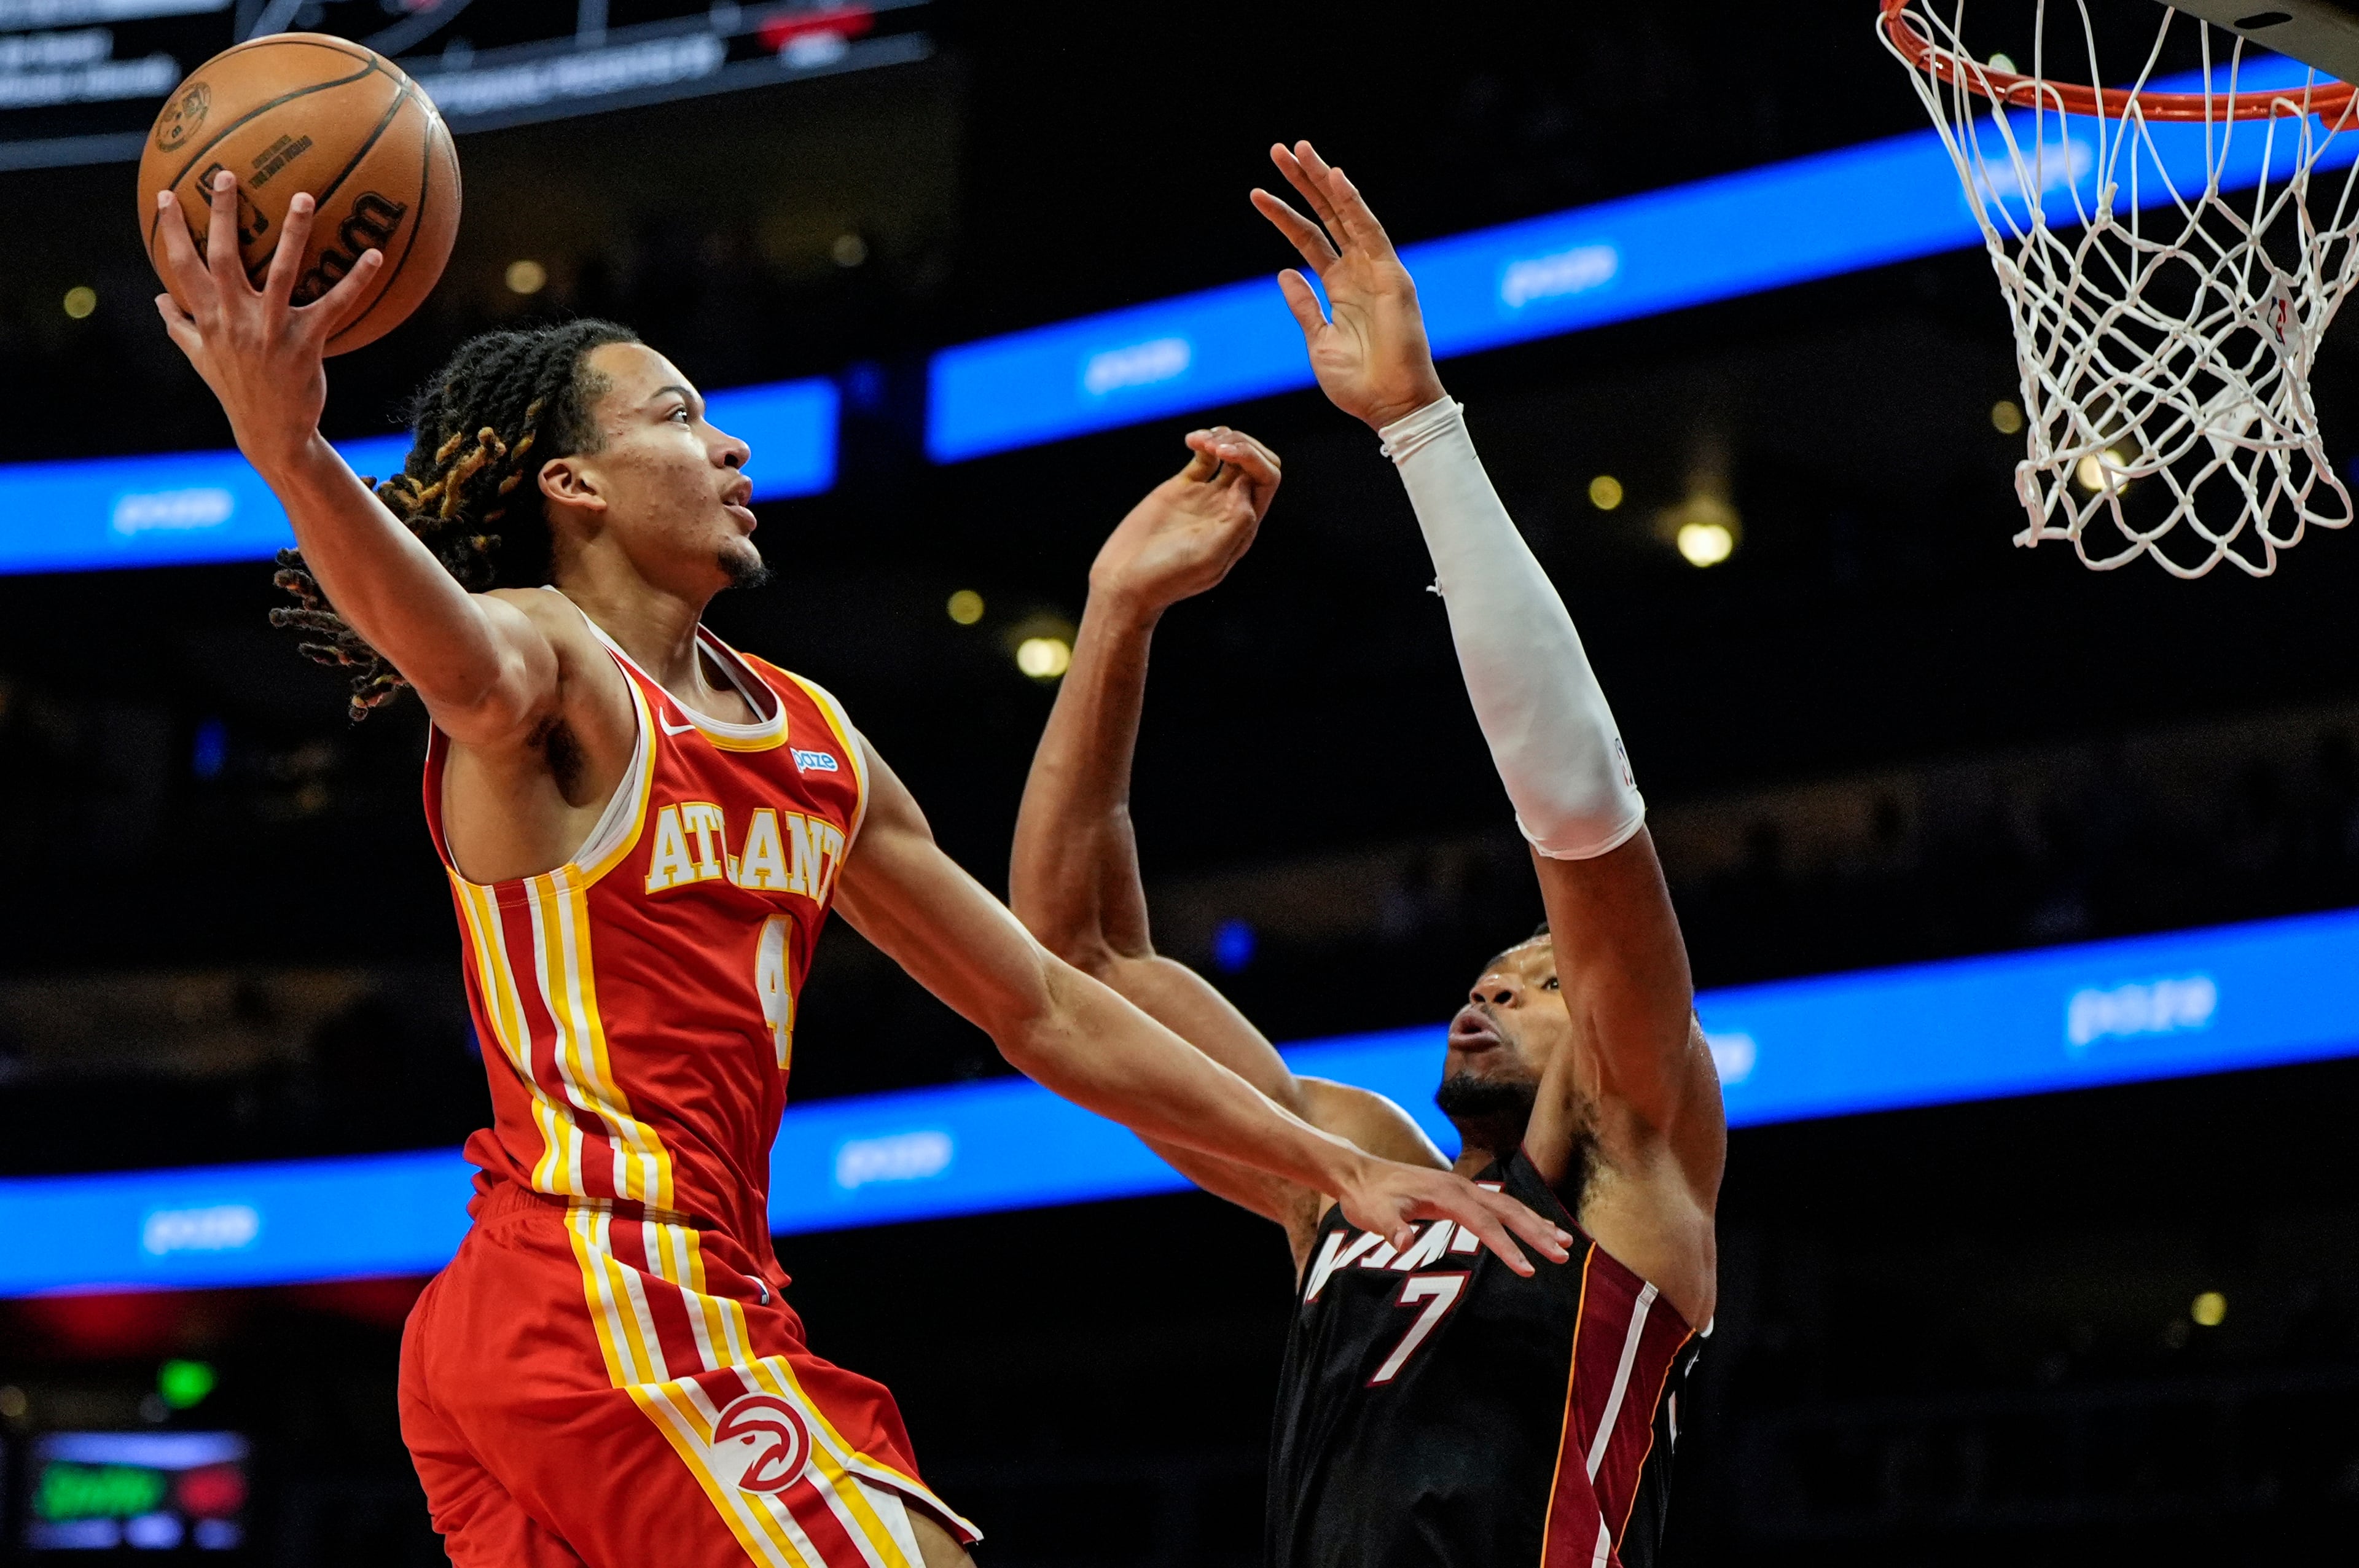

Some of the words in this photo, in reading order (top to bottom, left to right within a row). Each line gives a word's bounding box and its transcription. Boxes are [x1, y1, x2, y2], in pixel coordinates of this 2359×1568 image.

[791, 749, 836, 772] paze
[754, 913, 794, 1071] 4
[1364, 1270, 1473, 1389] 7
